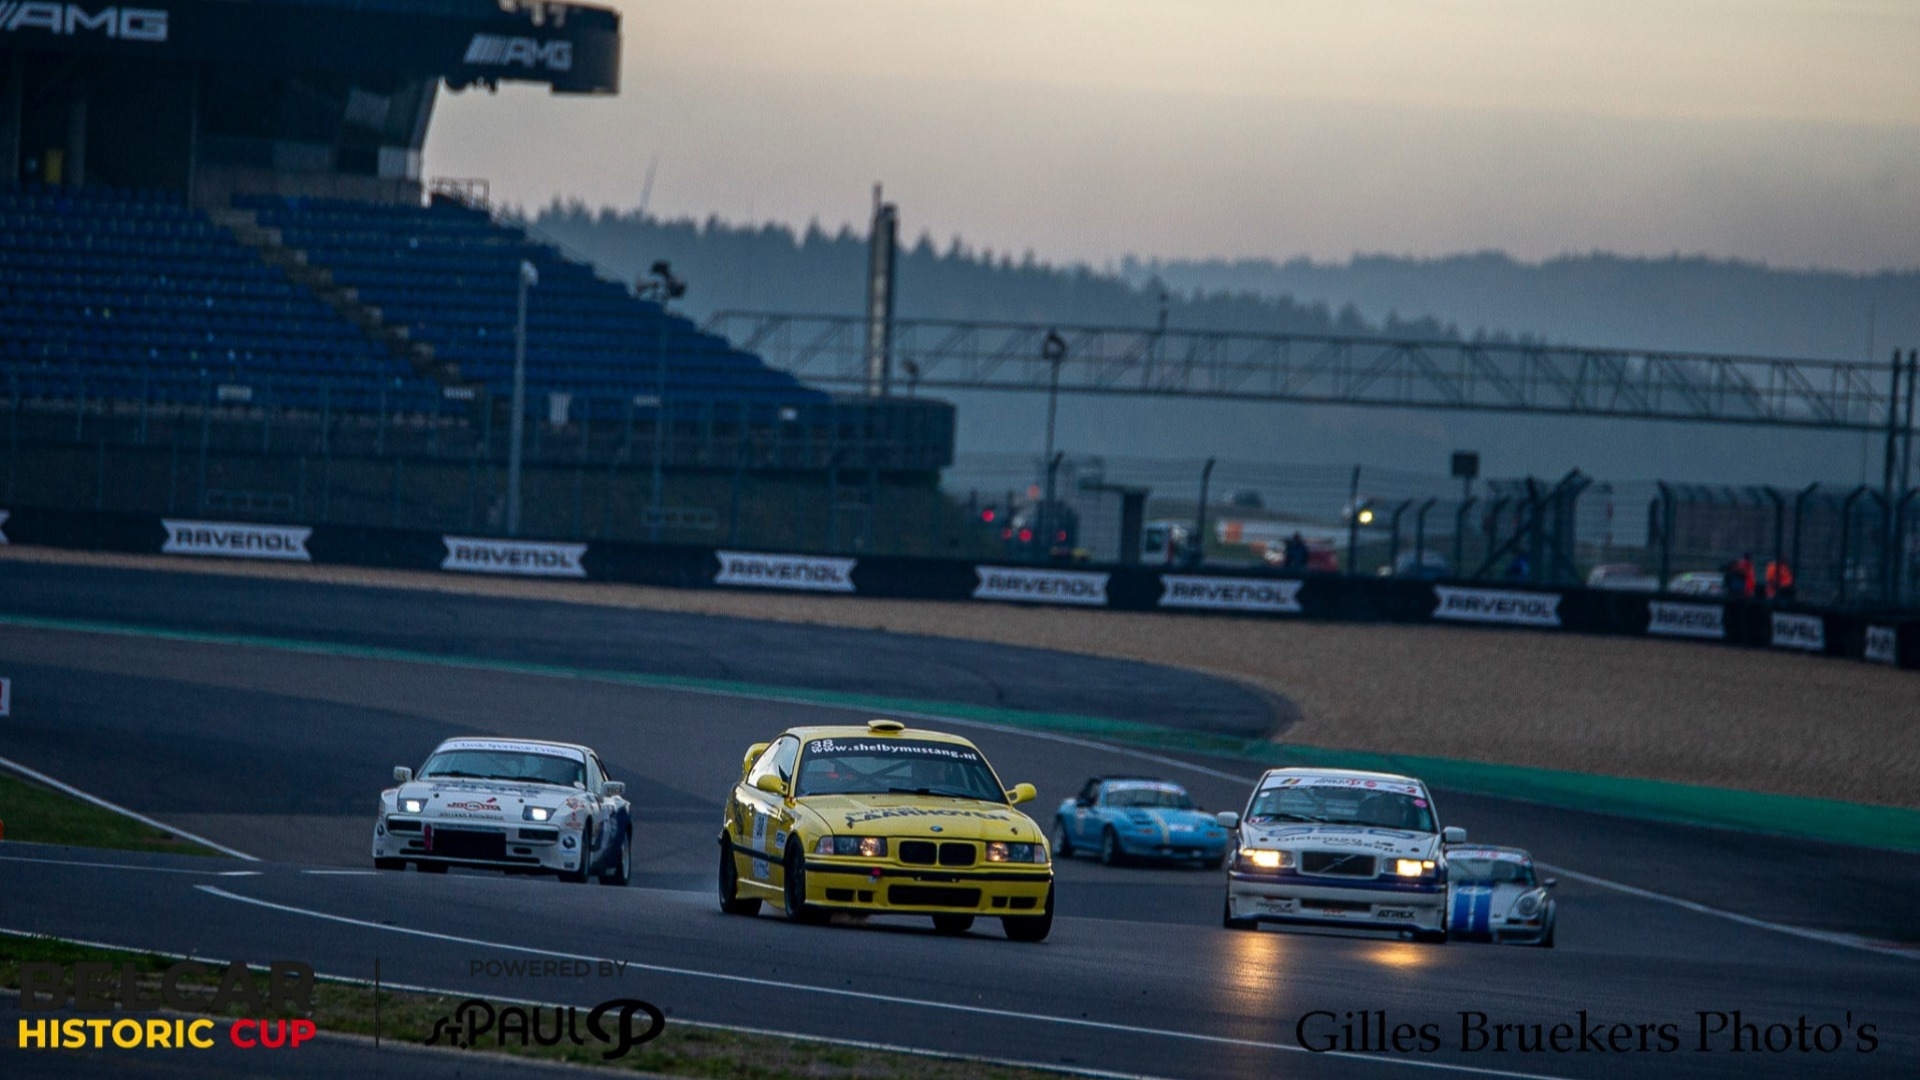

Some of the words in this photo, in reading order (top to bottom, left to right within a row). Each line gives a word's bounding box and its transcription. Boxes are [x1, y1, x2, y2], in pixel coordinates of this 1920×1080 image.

[6, 2, 168, 41] AMG
[504, 36, 572, 71] AMG
[174, 527, 301, 553] RAVENOL
[455, 544, 575, 570] RAVENOL
[728, 558, 846, 586] RAVENOL
[985, 574, 1101, 599] RAVENOL
[1170, 582, 1292, 607] RAVENOL
[1446, 592, 1555, 618] RAVENOL
[811, 739, 834, 750] 38
[811, 744, 978, 762] www.shelbymustang.nl
[1376, 909, 1416, 920] ATREX
